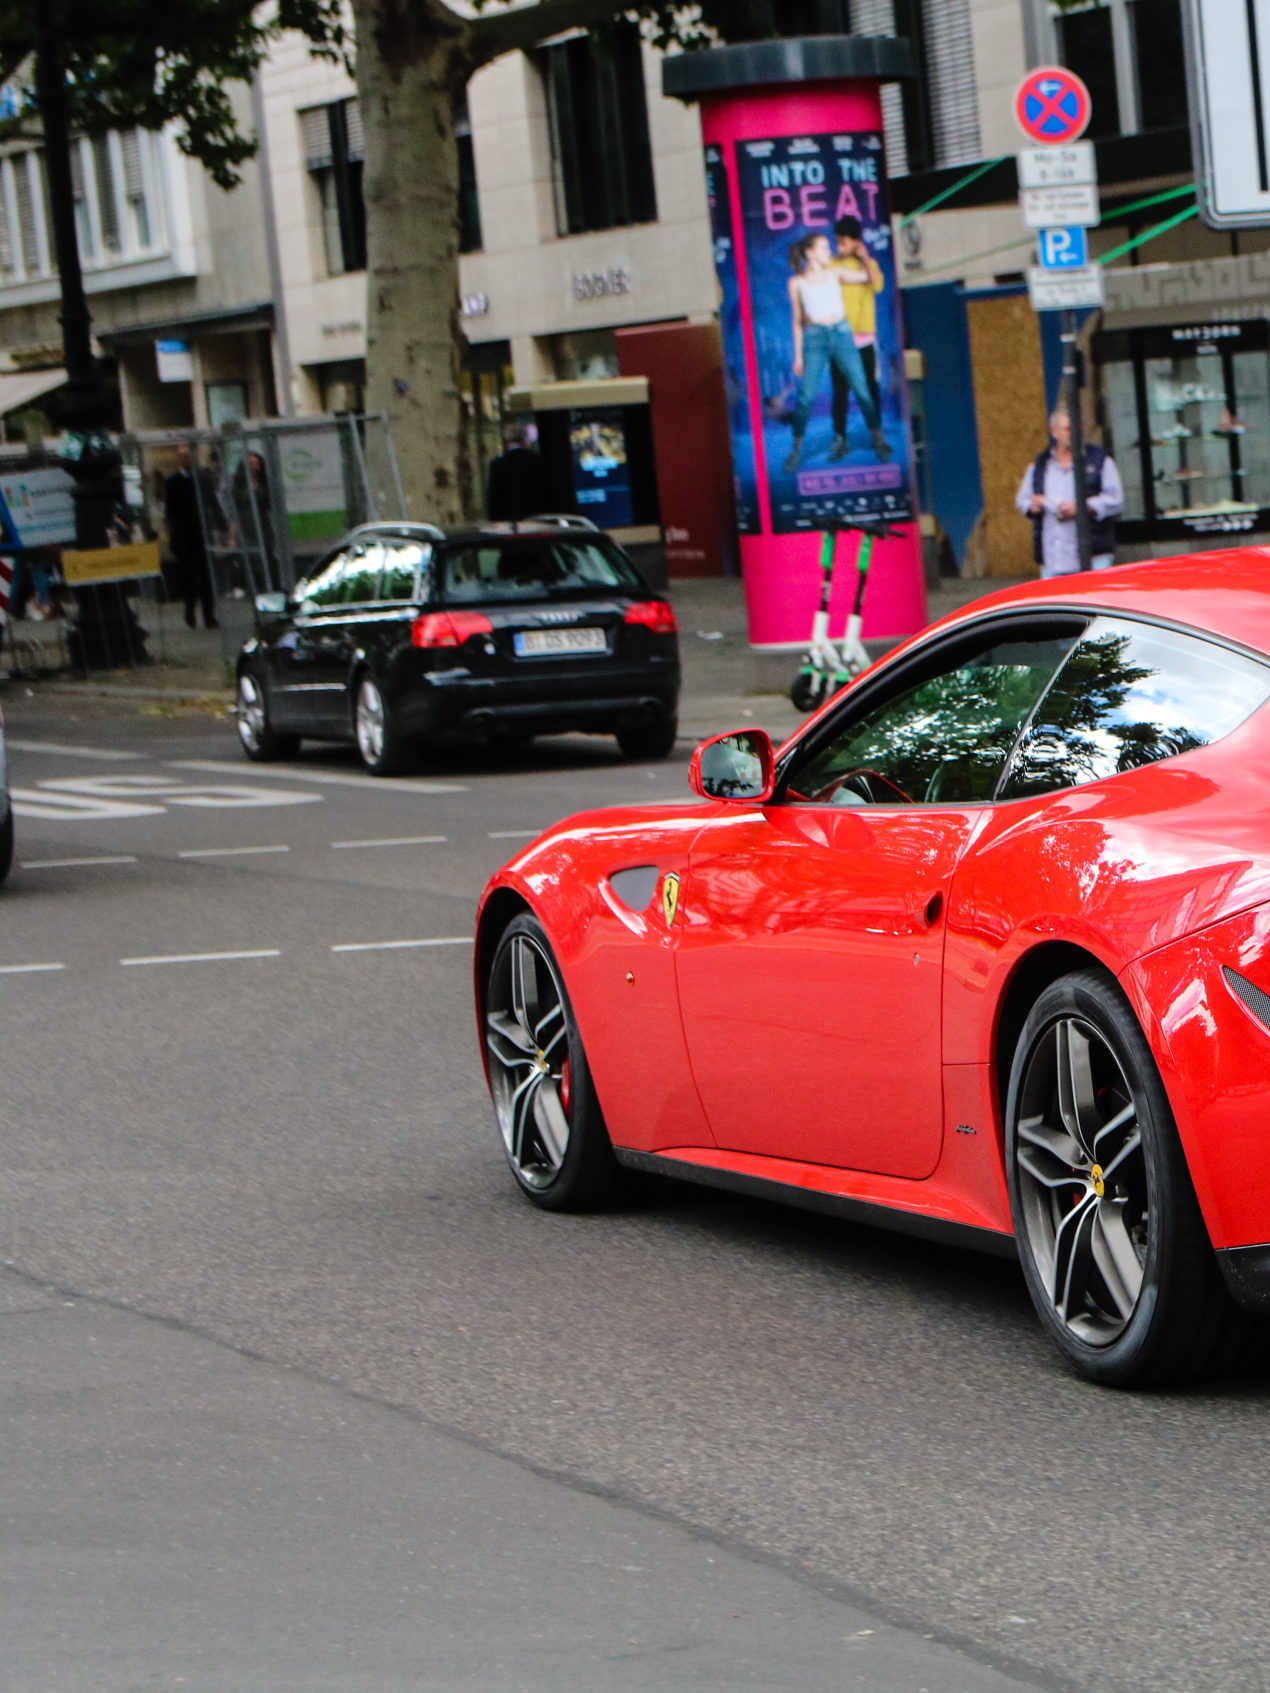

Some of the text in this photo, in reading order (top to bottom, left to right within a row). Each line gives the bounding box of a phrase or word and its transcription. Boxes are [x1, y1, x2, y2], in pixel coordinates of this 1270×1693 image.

[761, 156, 879, 189] INTO THE
[763, 181, 880, 231] BEAT
[1046, 229, 1072, 265] P
